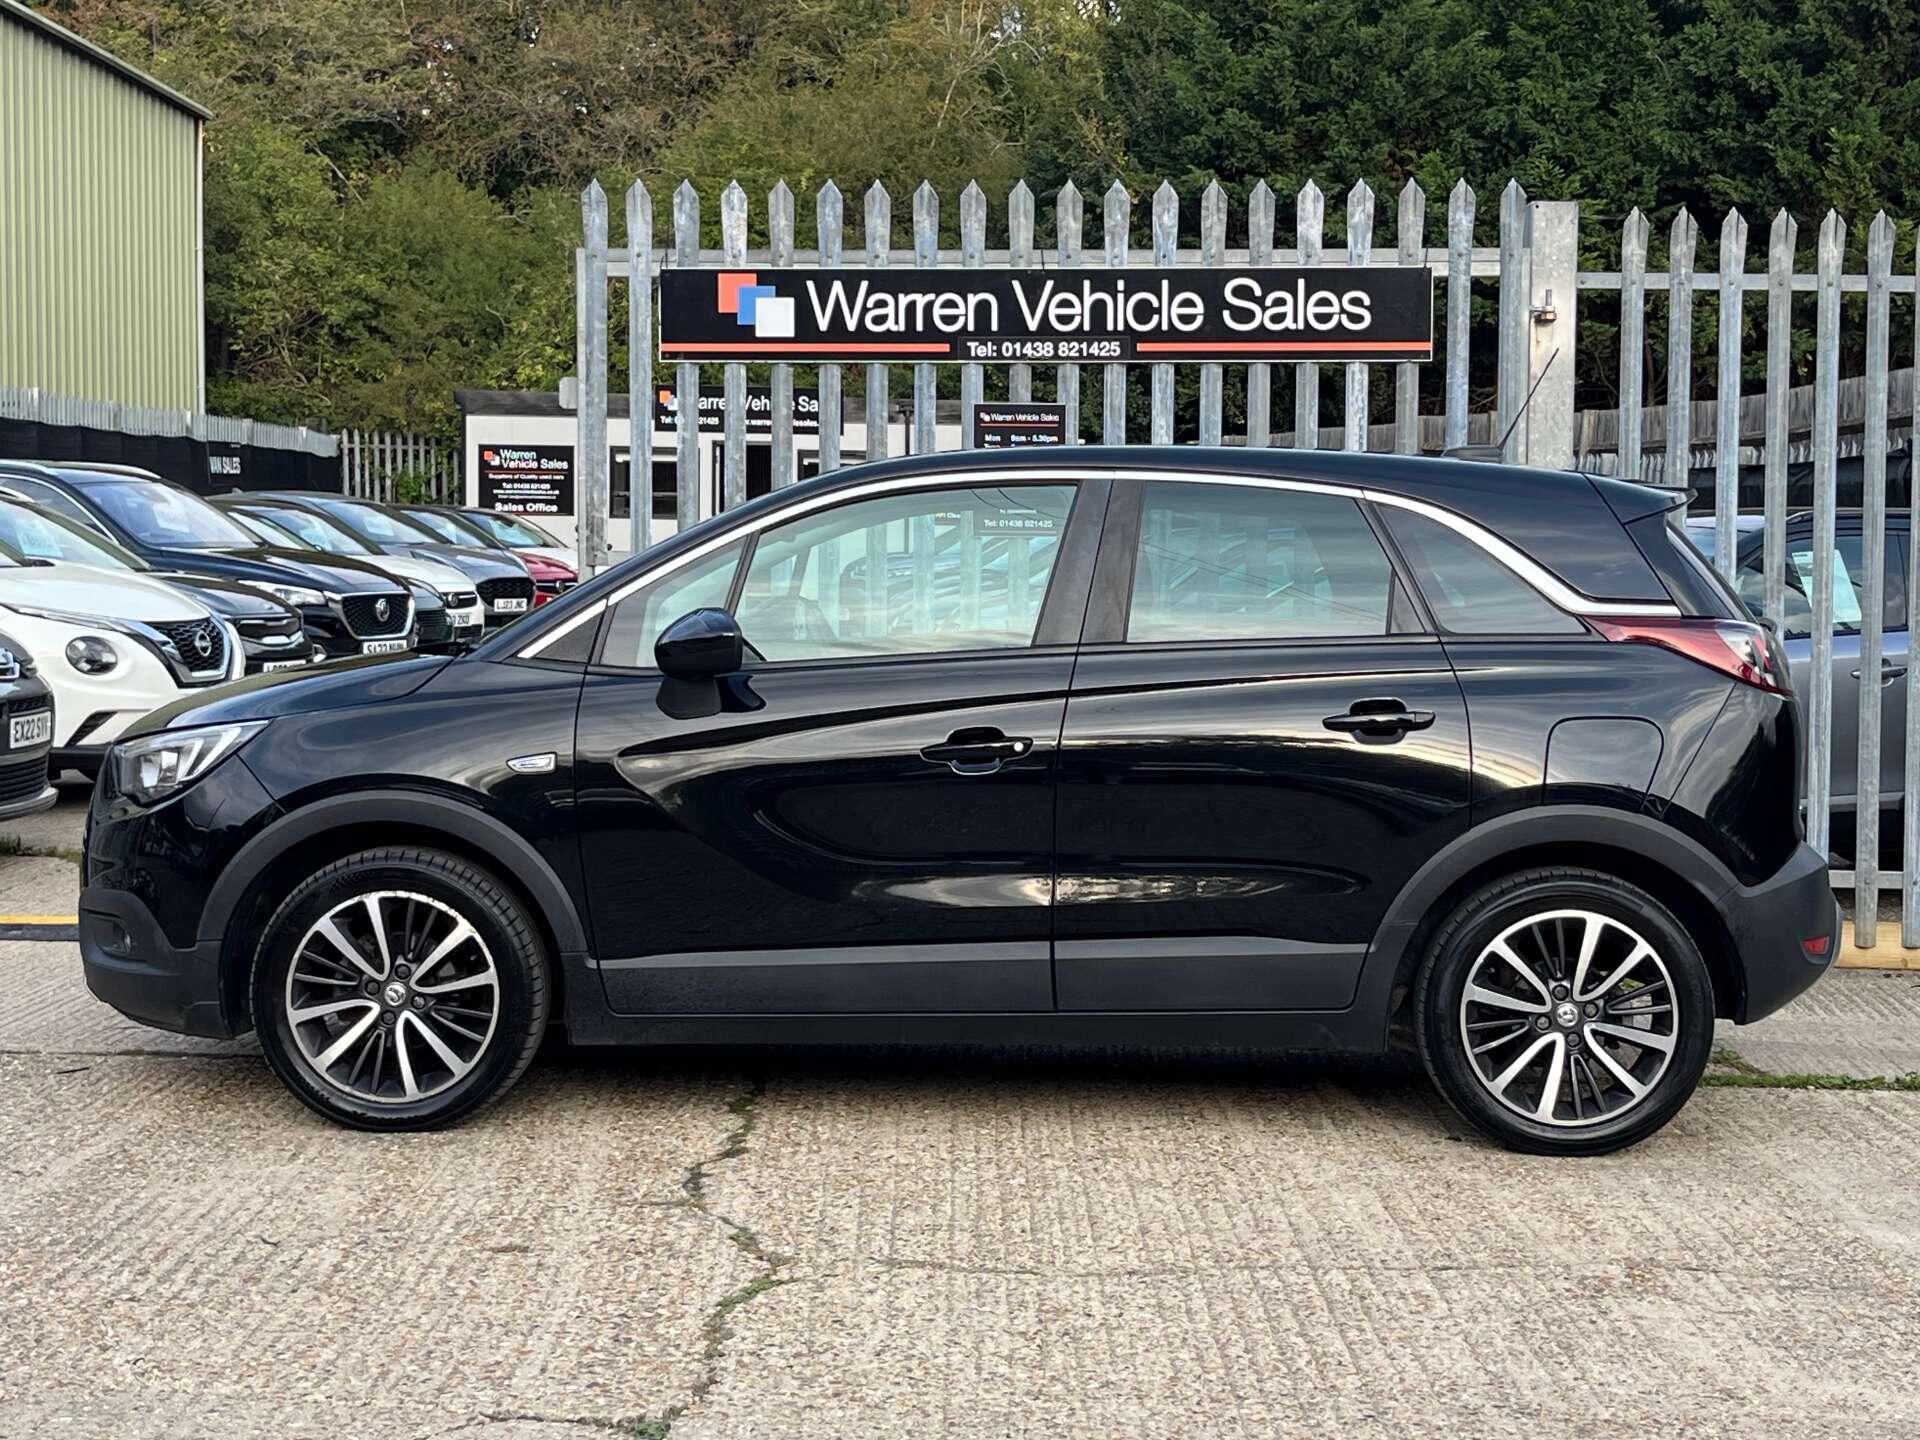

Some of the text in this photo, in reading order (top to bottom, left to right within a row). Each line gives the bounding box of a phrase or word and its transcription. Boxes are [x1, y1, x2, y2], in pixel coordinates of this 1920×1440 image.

[806, 276, 1372, 333] Warren Vehicle Sales
[967, 341, 1121, 358] Tel: 01438 821425
[500, 449, 537, 459] Warren
[501, 458, 569, 470] Vehicle Sales
[495, 502, 558, 513] Sales Office
